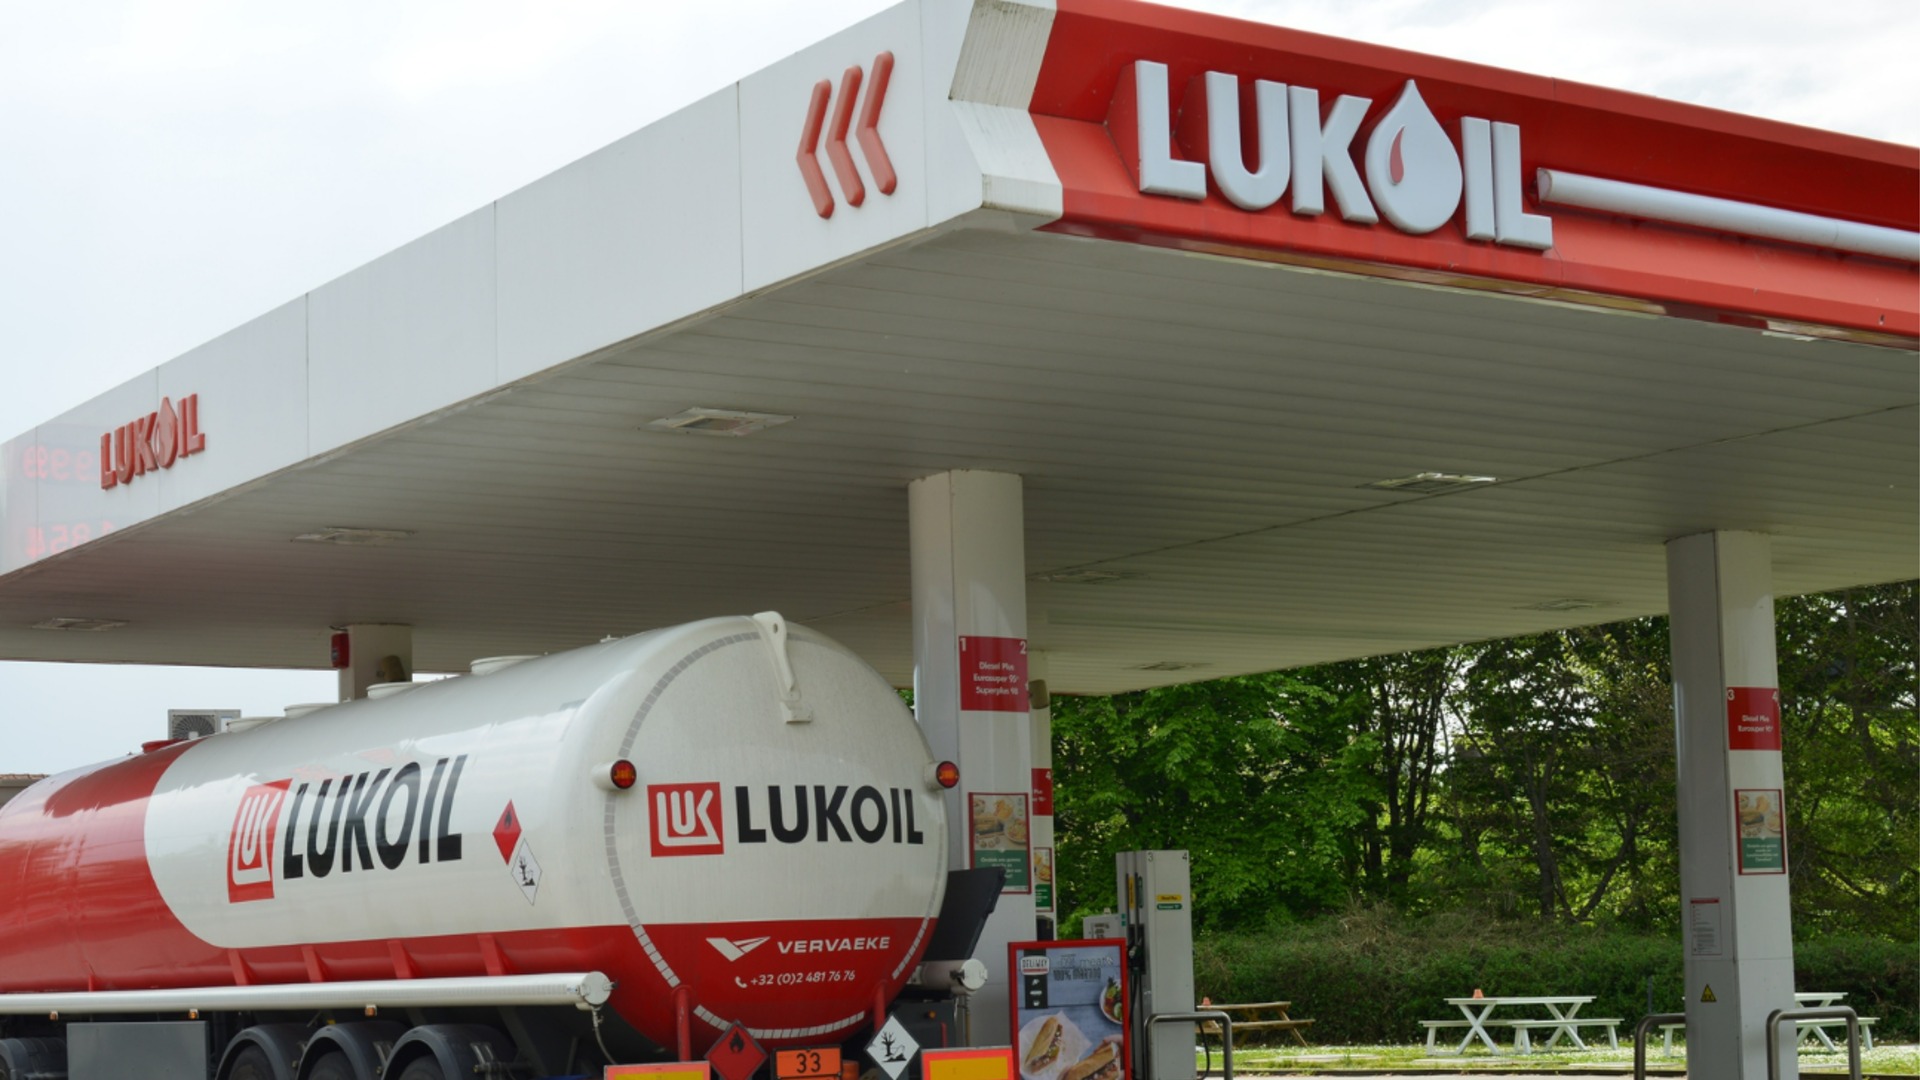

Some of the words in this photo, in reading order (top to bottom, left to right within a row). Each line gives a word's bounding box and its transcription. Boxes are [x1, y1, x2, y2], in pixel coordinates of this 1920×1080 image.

[1135, 60, 1553, 251] LUKOIL
[100, 393, 206, 490] LUKOIL
[960, 638, 966, 651] 1
[1020, 641, 1026, 654] 2
[979, 661, 1000, 670] Diesel
[1002, 662, 1014, 671] Plus
[1727, 689, 1735, 701] 3
[1772, 690, 1779, 702] 4
[283, 753, 469, 880] LUKOIL
[735, 785, 924, 845] LUKOIL
[1147, 851, 1153, 862] 3
[777, 936, 891, 955] VERVAEKE
[751, 974, 775, 987] +32
[776, 972, 803, 986] (0)2
[805, 971, 826, 983] 481
[828, 971, 841, 982] 76
[843, 970, 856, 982] 76
[796, 1052, 822, 1075] 33
